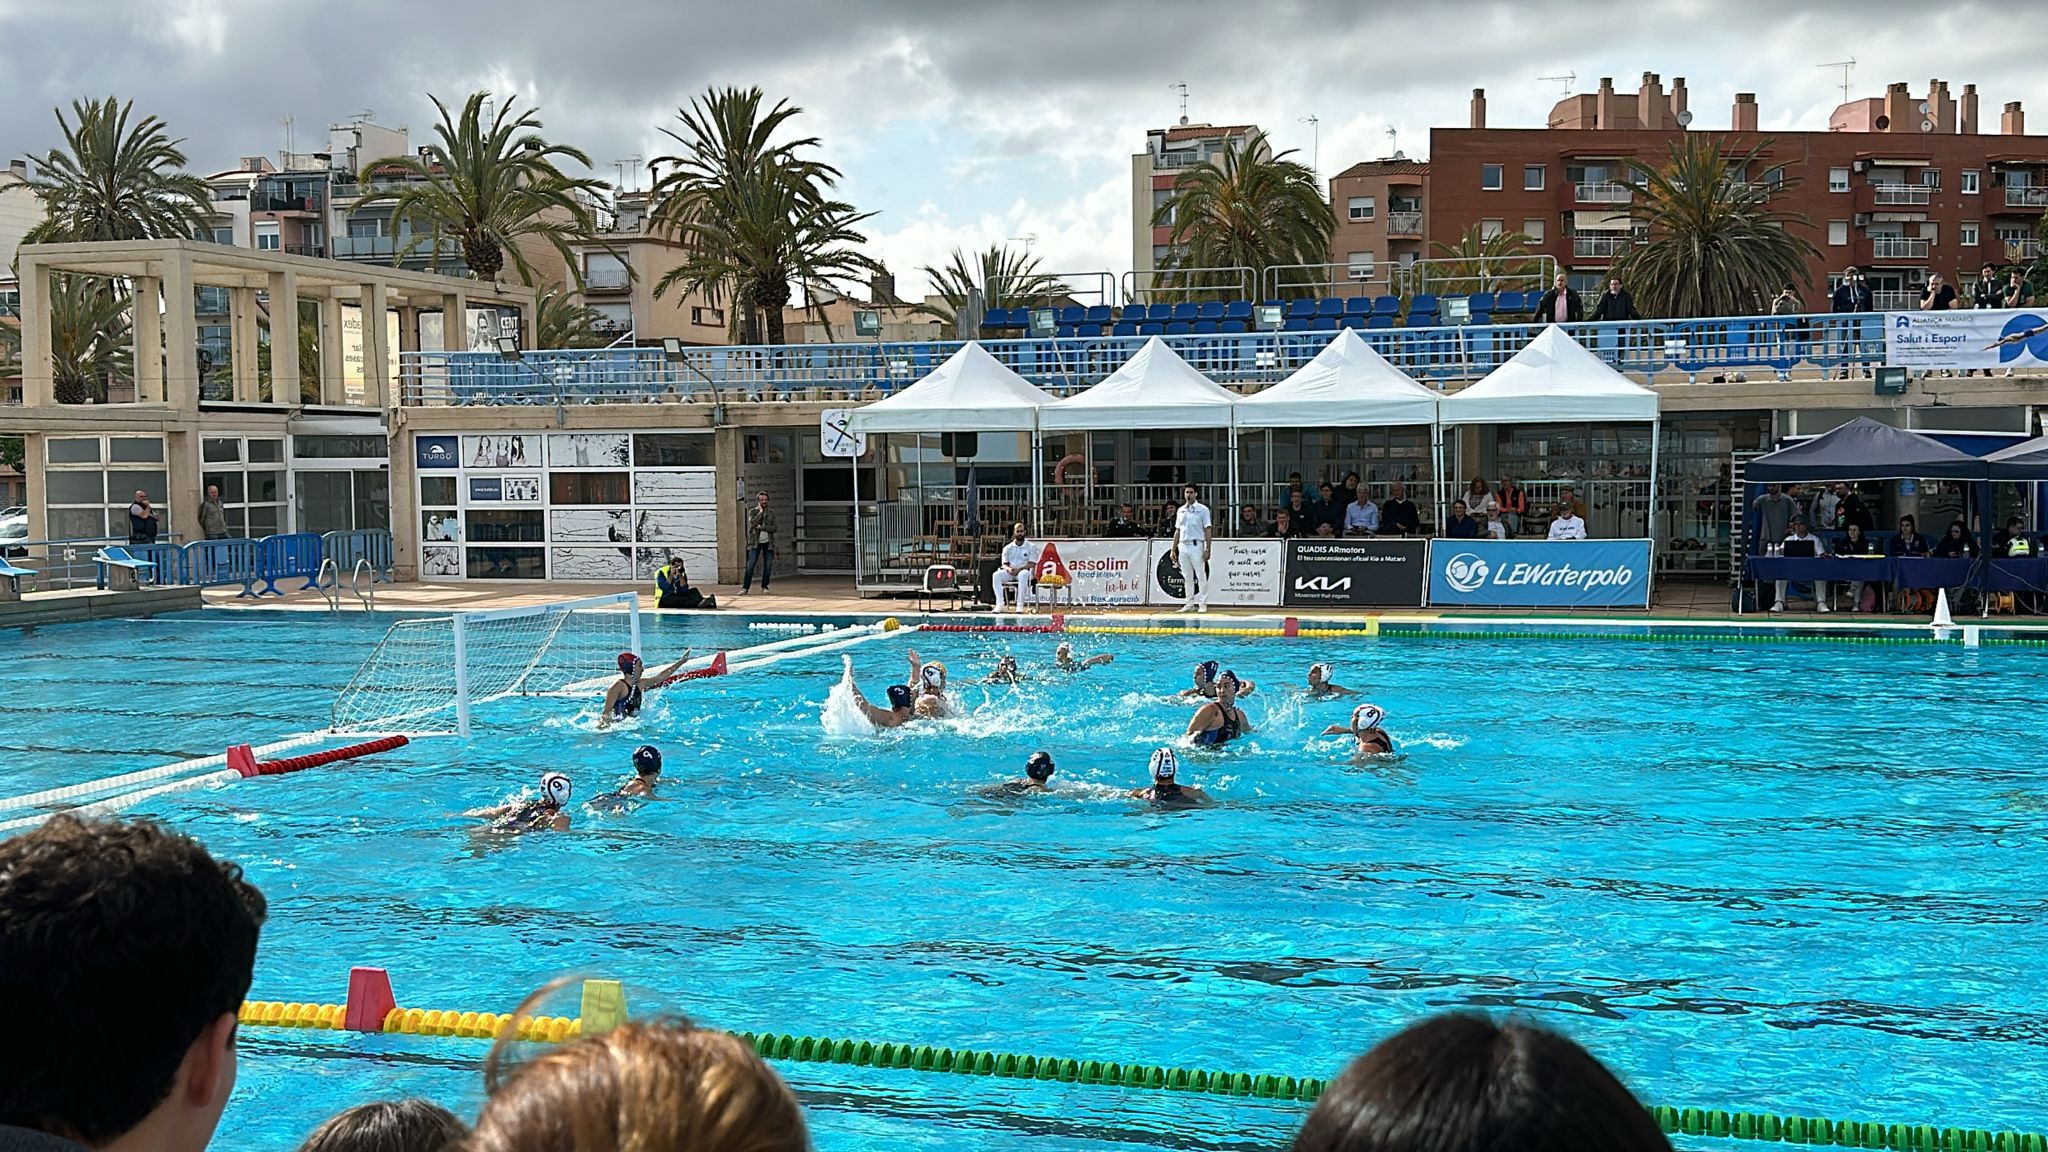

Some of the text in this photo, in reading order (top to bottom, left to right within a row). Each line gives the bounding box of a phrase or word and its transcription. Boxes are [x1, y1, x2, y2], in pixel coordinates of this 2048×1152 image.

[501, 316, 518, 329] CENT
[1896, 333, 1922, 344] Salut
[1931, 333, 1967, 345] Esport
[422, 452, 452, 460] TURBO
[1297, 545, 1366, 554] QUADIS ARmotors
[1069, 557, 1129, 571] assolim
[1078, 570, 1096, 578] food
[1492, 562, 1633, 592] LEWaterpolo
[894, 686, 905, 695] 3
[1366, 709, 1376, 718] 8
[552, 781, 563, 791] 9
